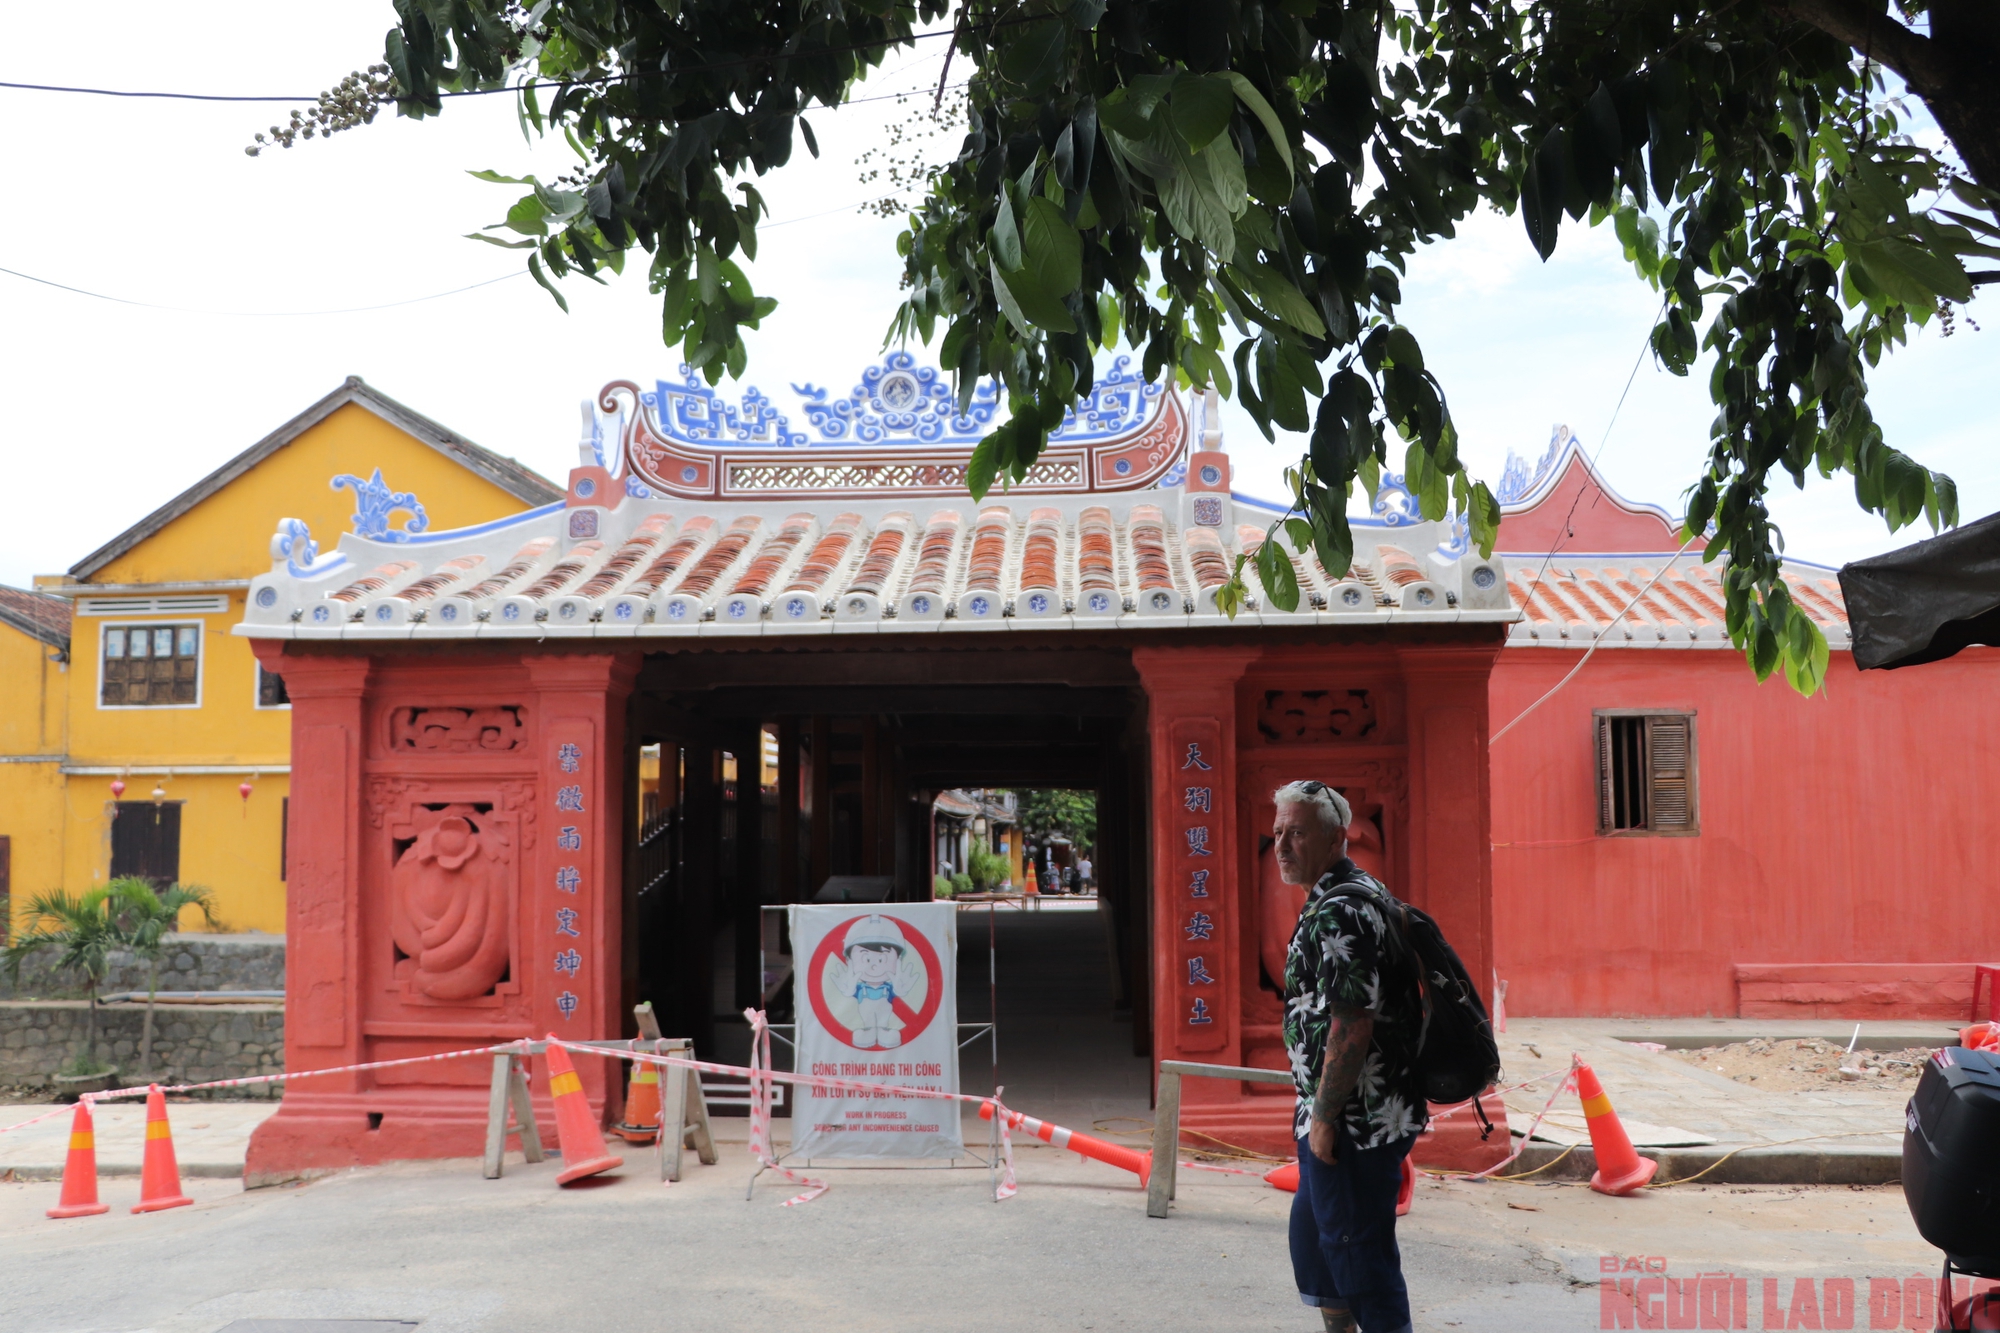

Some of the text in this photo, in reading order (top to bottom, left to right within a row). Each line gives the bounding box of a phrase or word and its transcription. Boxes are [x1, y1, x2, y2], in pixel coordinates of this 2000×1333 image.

[812, 1060, 941, 1077] CÔNG TRÌNH ĐANG THI CÔNG
[812, 1085, 827, 1098] XIN
[845, 1111, 907, 1119] WORK IN PROGRESS
[848, 1124, 861, 1132] ANY
[863, 1124, 912, 1132] INCONVENIENCE
[915, 1124, 939, 1132] CAUSED
